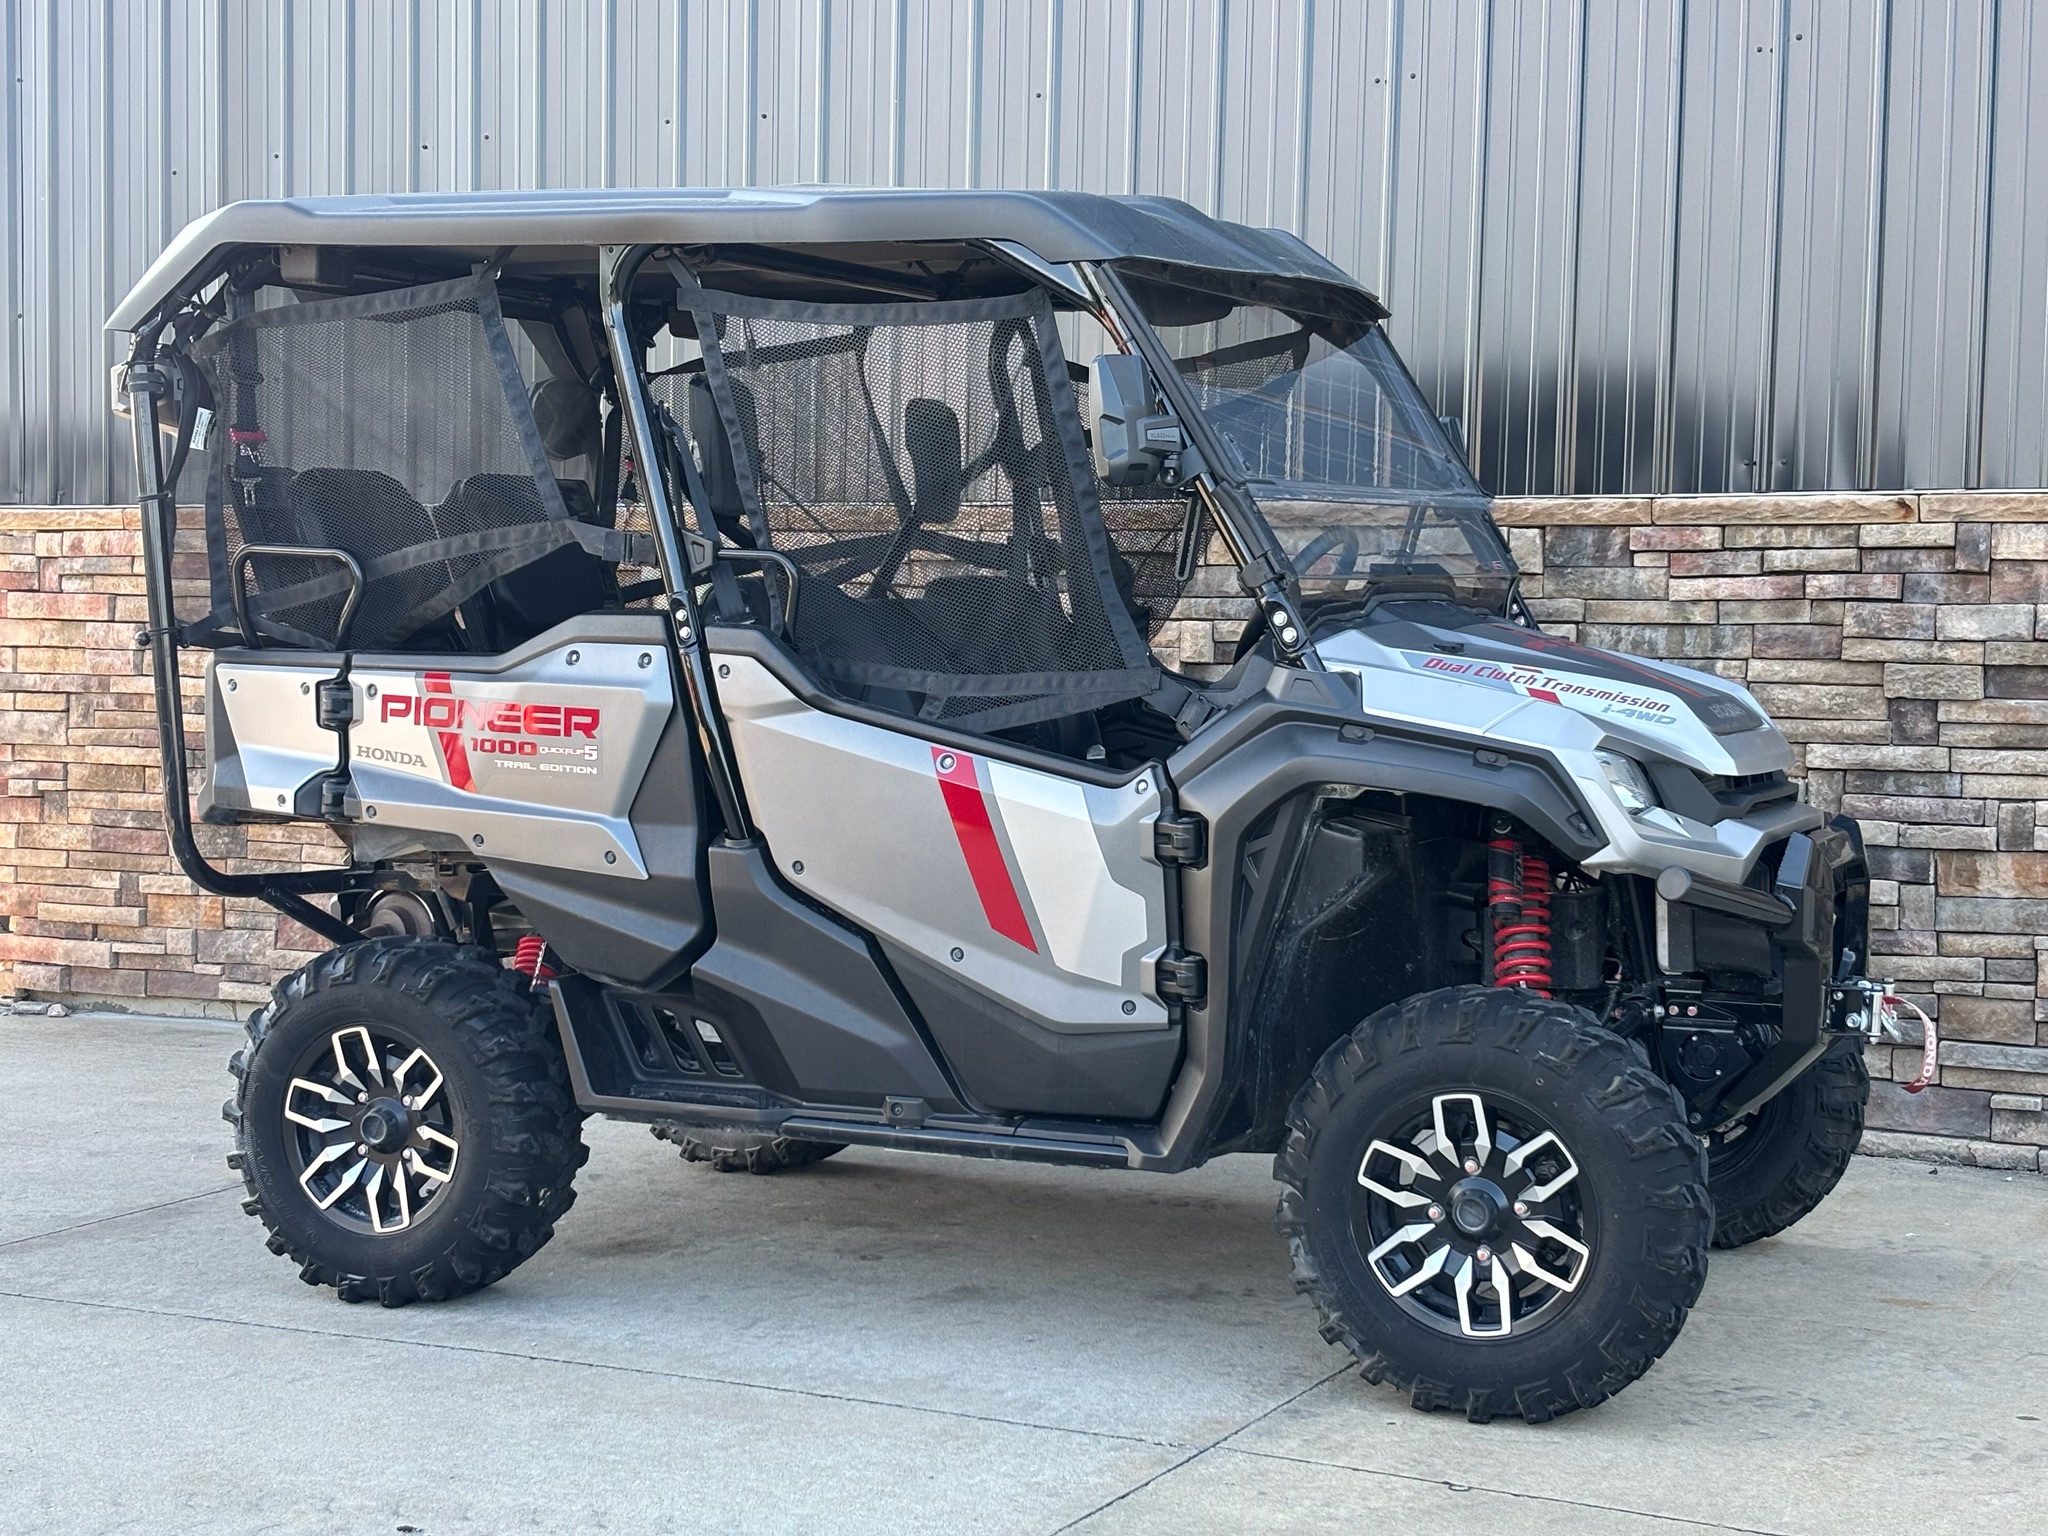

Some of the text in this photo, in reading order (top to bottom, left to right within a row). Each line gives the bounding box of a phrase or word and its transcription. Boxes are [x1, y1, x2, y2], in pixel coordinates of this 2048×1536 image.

[1422, 658, 1670, 713] Dual Clutch Transmission
[381, 694, 600, 739] PIONEER
[356, 745, 427, 767] HONDA
[470, 737, 538, 756] 1000
[494, 759, 598, 775] TRAIL EDITION
